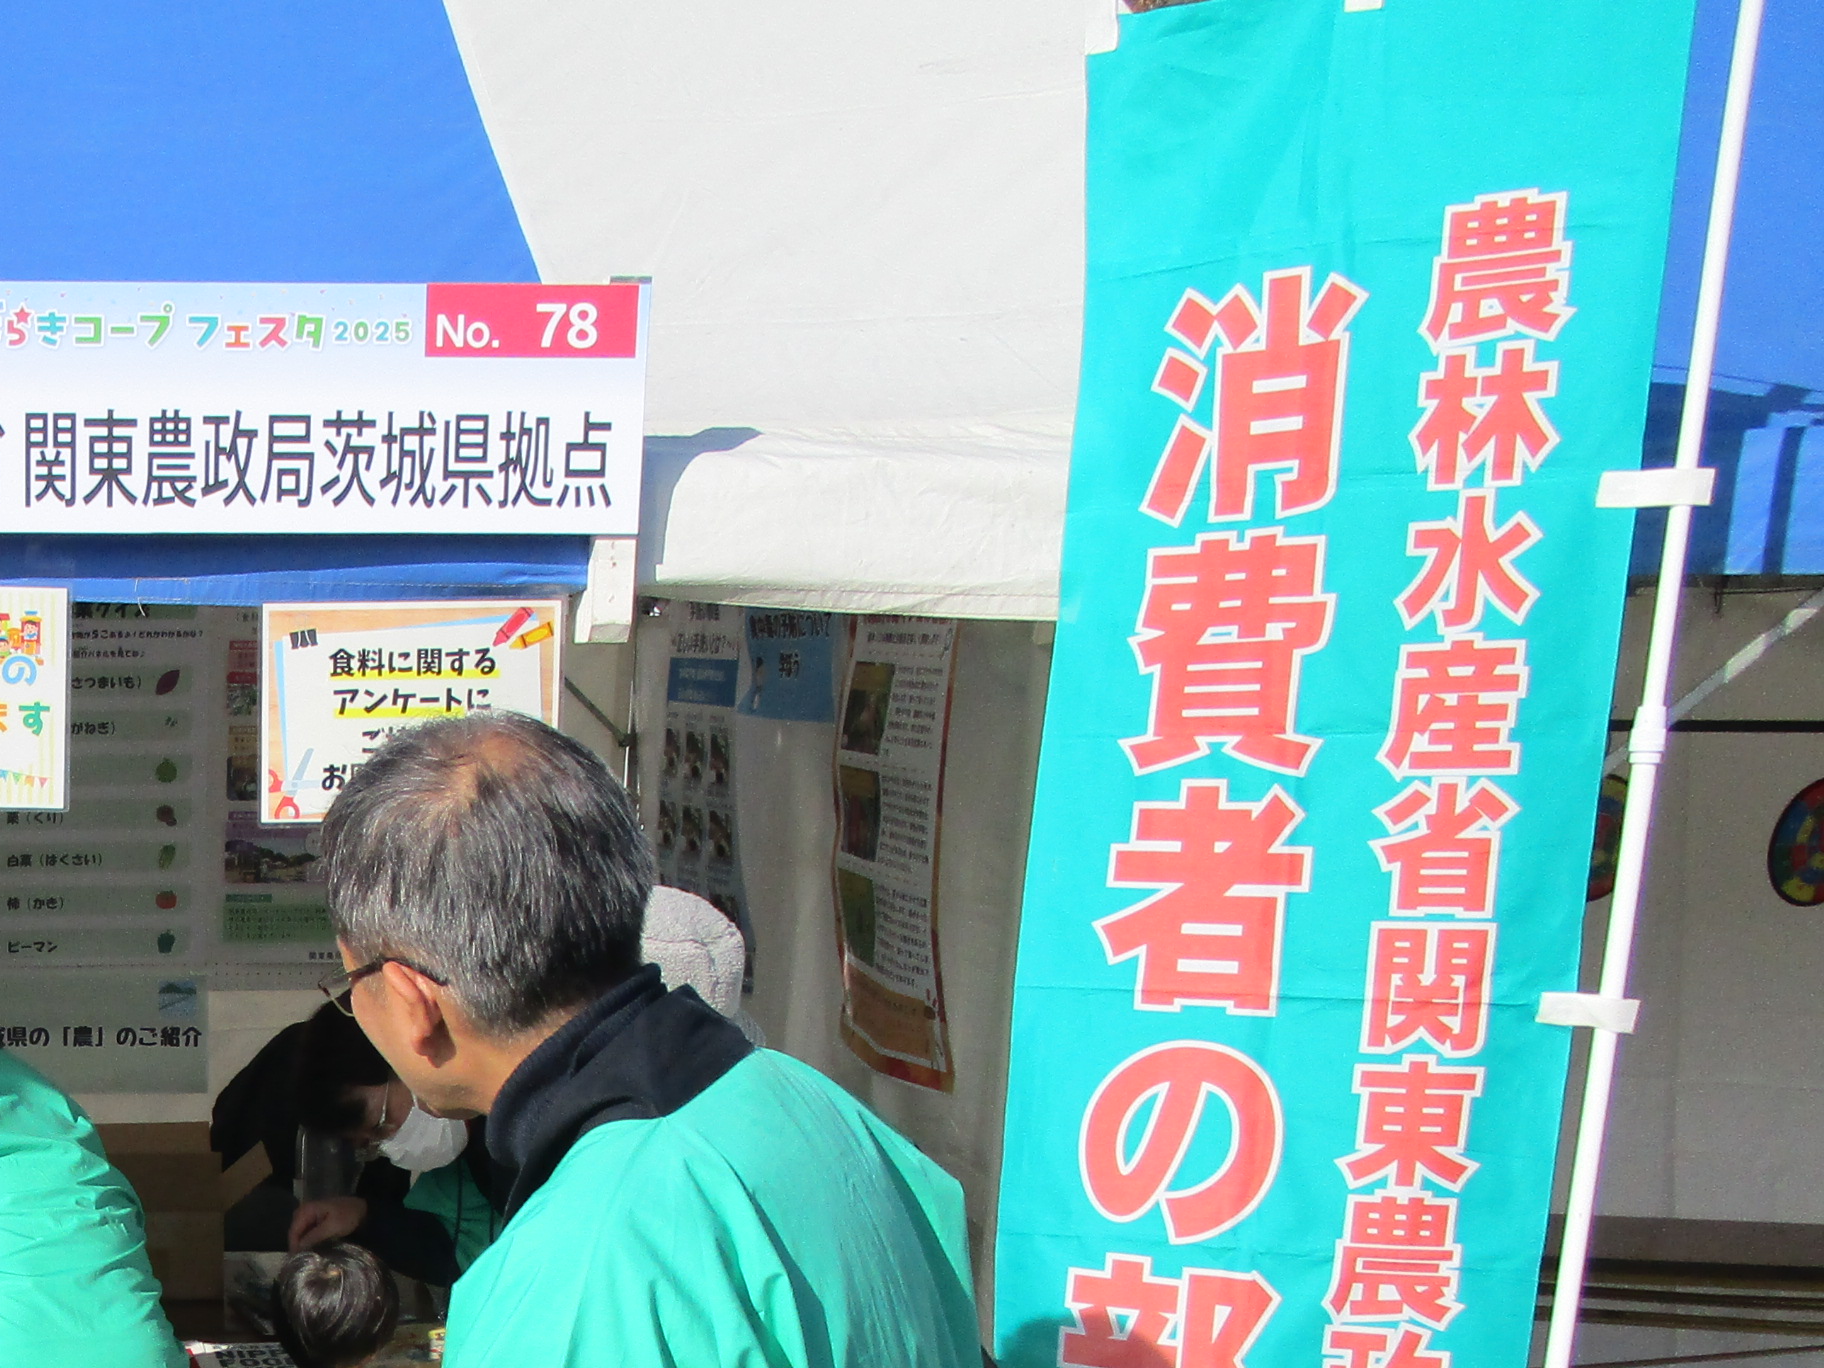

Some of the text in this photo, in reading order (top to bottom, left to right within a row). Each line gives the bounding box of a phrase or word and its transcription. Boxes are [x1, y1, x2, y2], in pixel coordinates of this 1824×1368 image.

[186, 313, 324, 350] フェスタ
[333, 319, 413, 343] 2025
[435, 302, 599, 349] No. 78
[24, 407, 613, 509] 関東農政局茨城県拠点
[328, 647, 497, 677] 食料に関する
[332, 687, 493, 715] アンケートに
[6, 940, 59, 955] ピーマン
